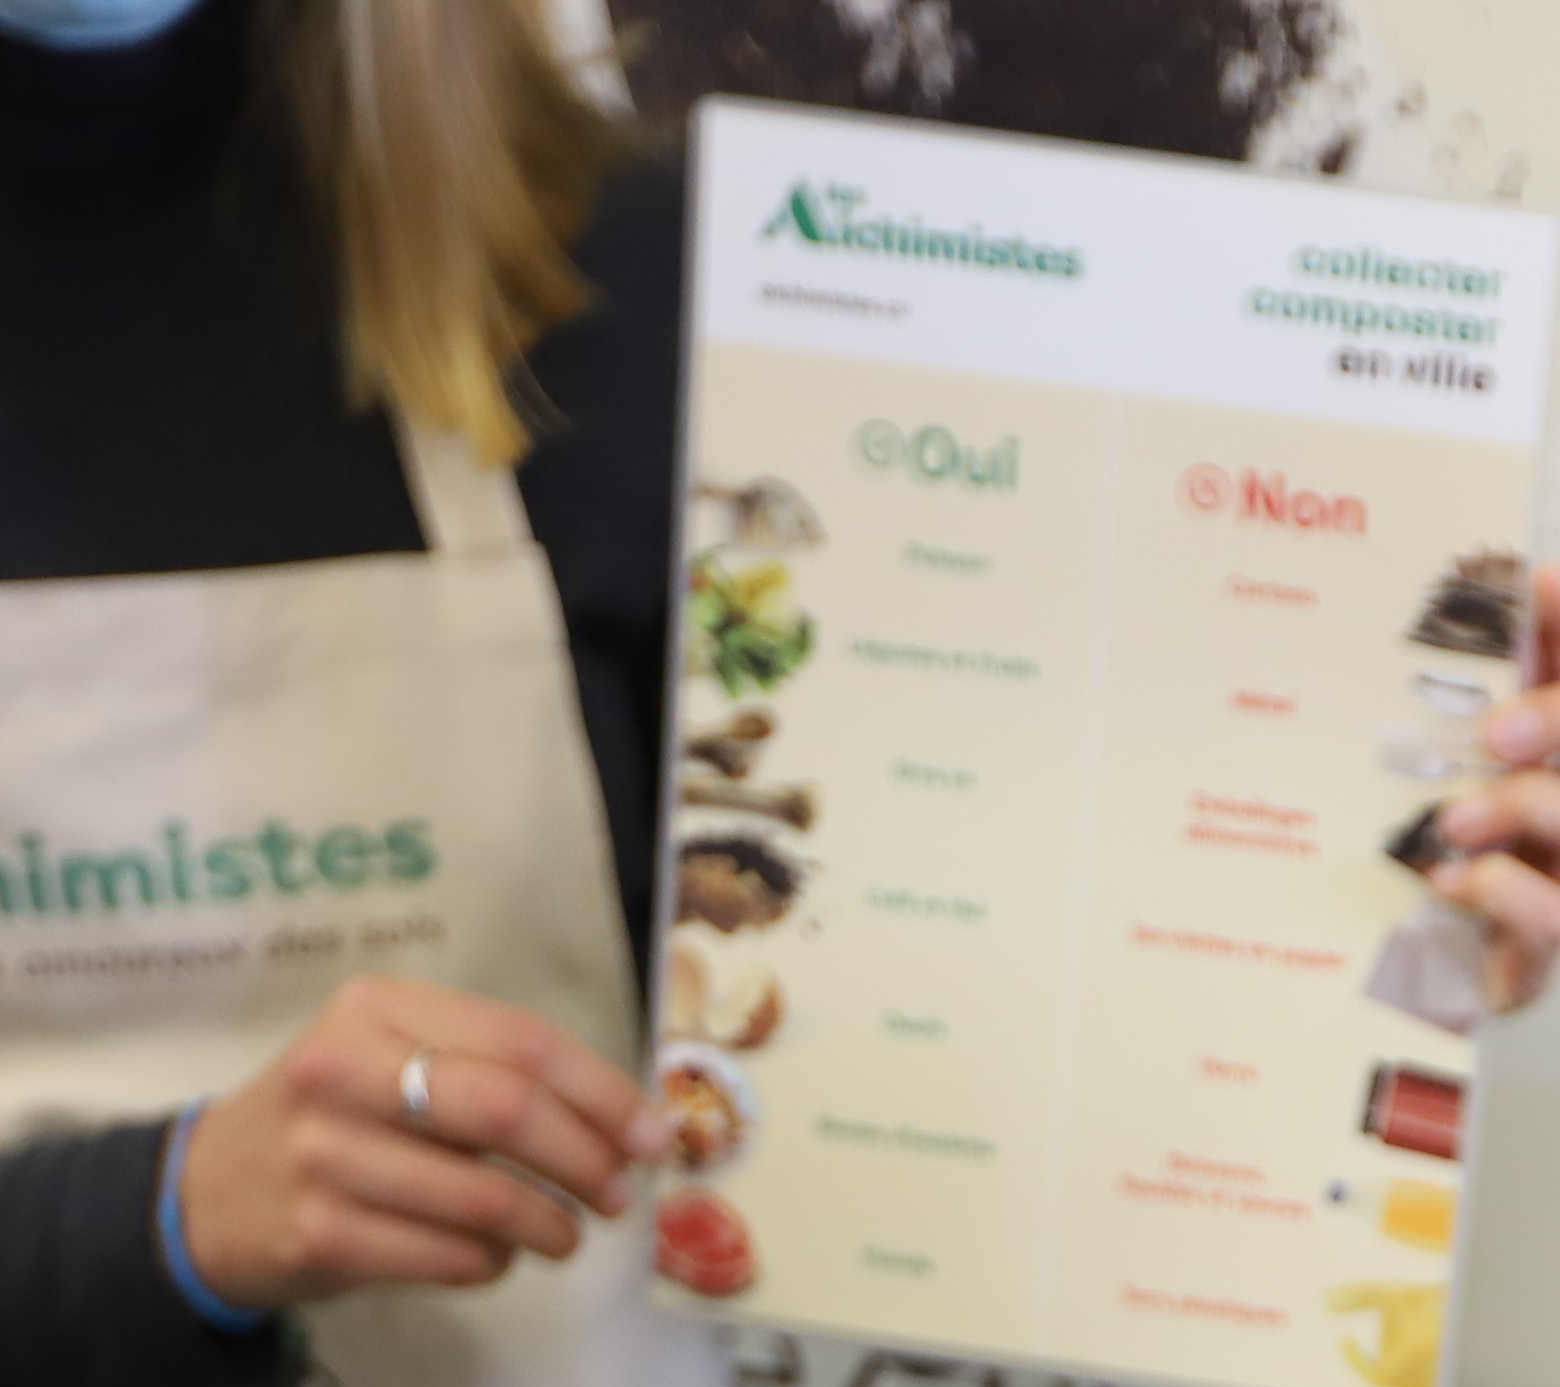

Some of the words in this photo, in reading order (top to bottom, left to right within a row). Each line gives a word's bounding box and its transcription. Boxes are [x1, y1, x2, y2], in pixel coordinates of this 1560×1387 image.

[761, 174, 1086, 279] Alchimistes
[1296, 245, 1505, 299] collecter
[1244, 288, 1501, 343] composter
[1336, 347, 1391, 380] en
[1405, 350, 1496, 391] ville
[909, 424, 1022, 492] Oui
[1241, 468, 1368, 537] Non
